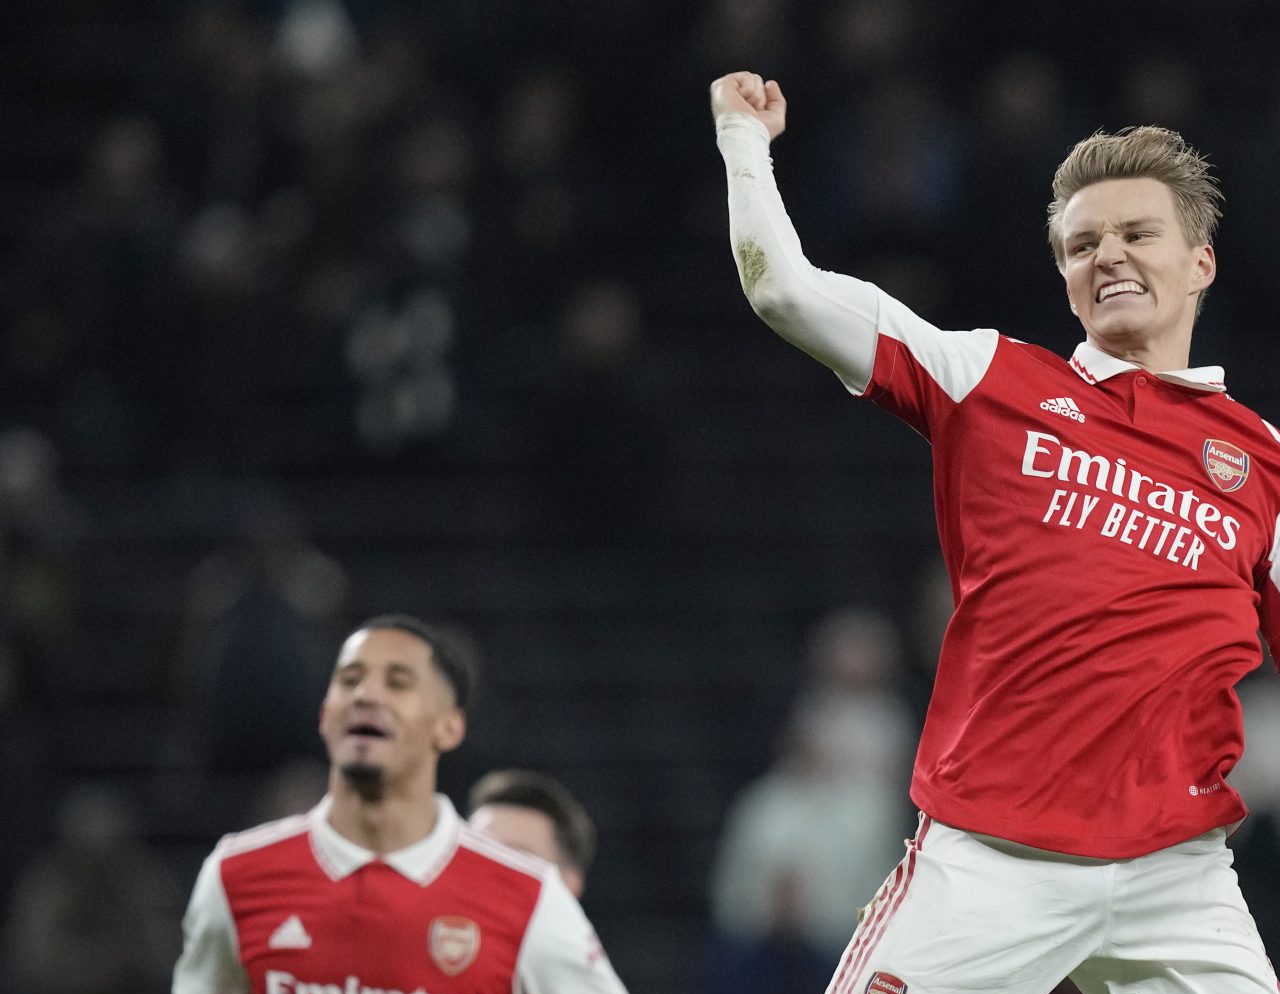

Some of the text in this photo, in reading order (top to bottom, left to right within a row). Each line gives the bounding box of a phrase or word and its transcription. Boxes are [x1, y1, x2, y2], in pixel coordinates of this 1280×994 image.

[1040, 401, 1086, 423] adidas
[1209, 446, 1243, 466] Arsenal
[1021, 430, 1241, 550] Emirates
[1042, 489, 1205, 571] FLY BETTER
[874, 977, 902, 994] Arsenal
